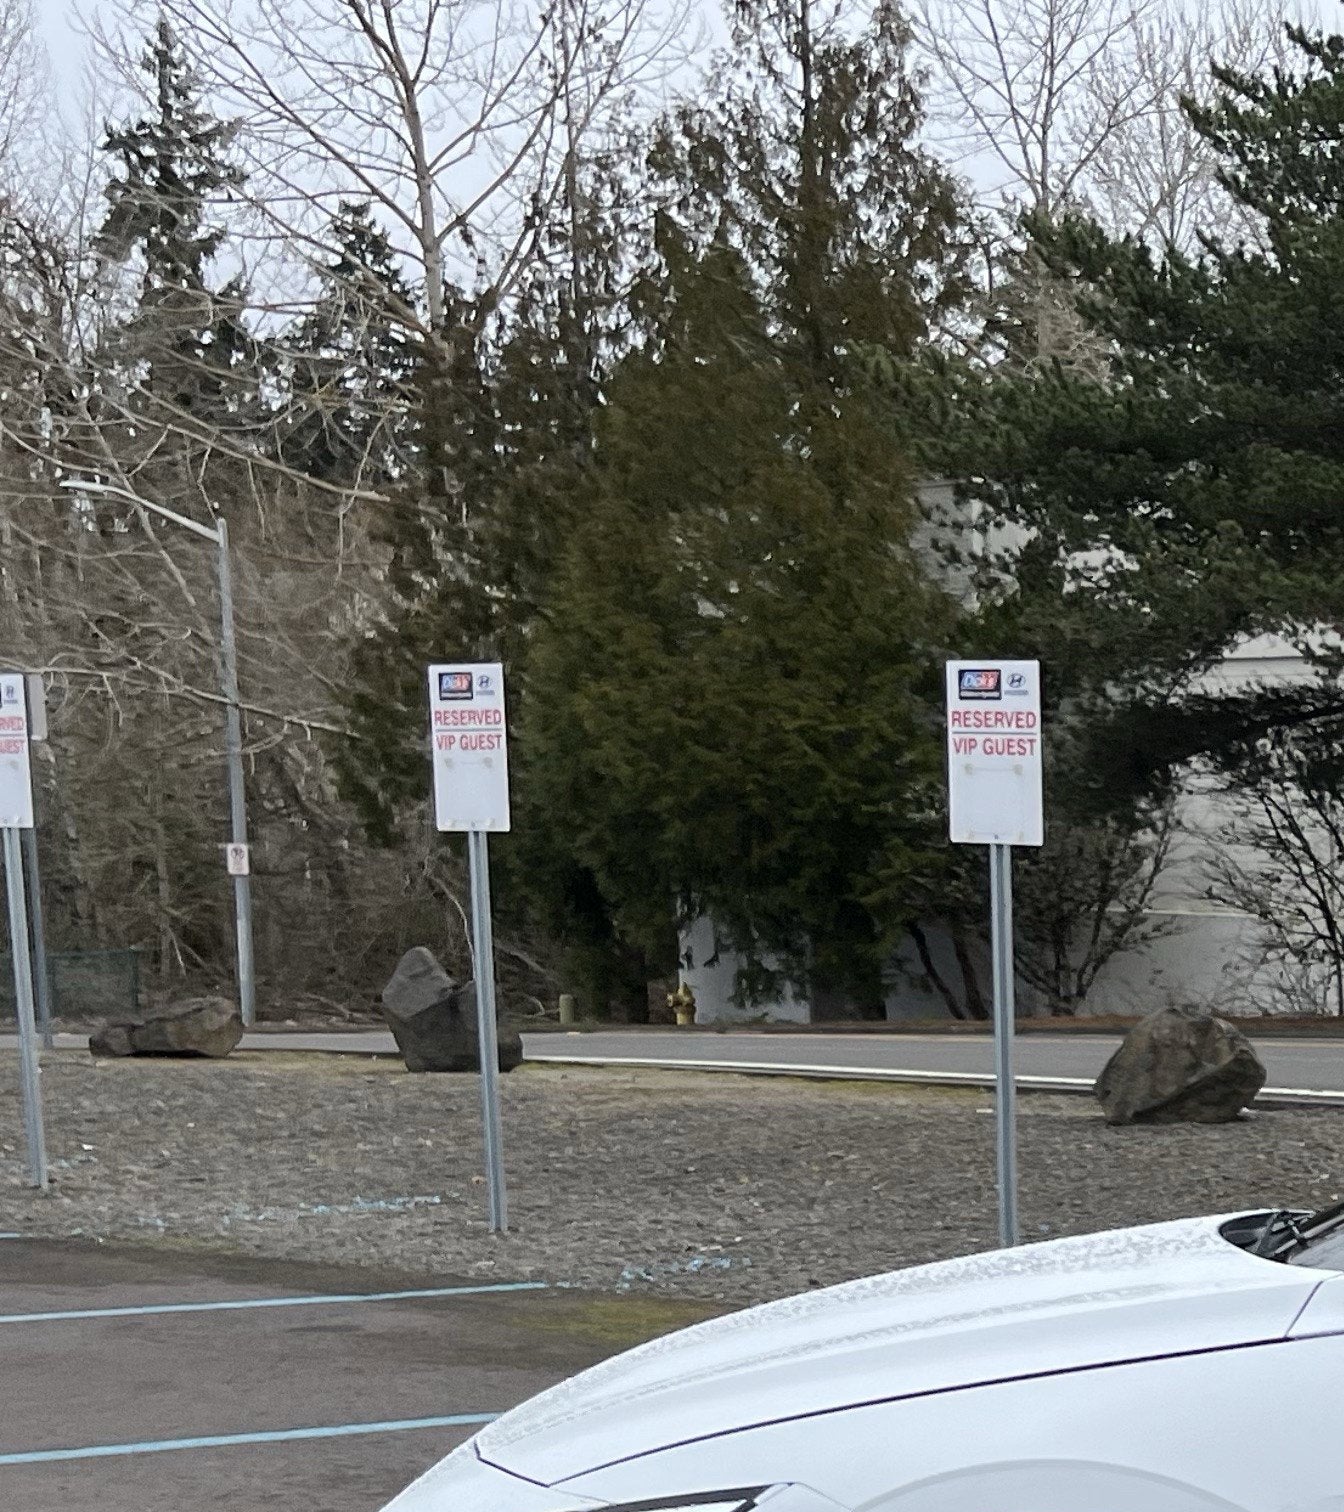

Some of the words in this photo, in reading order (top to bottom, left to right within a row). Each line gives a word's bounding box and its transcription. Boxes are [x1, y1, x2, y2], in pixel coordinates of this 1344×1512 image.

[434, 709, 502, 726] RESERVED
[951, 710, 1037, 729] RESERVED
[436, 735, 456, 750] VIP
[460, 733, 502, 751] GUEST
[953, 738, 977, 756] VIP
[983, 737, 1037, 756] GUEST
